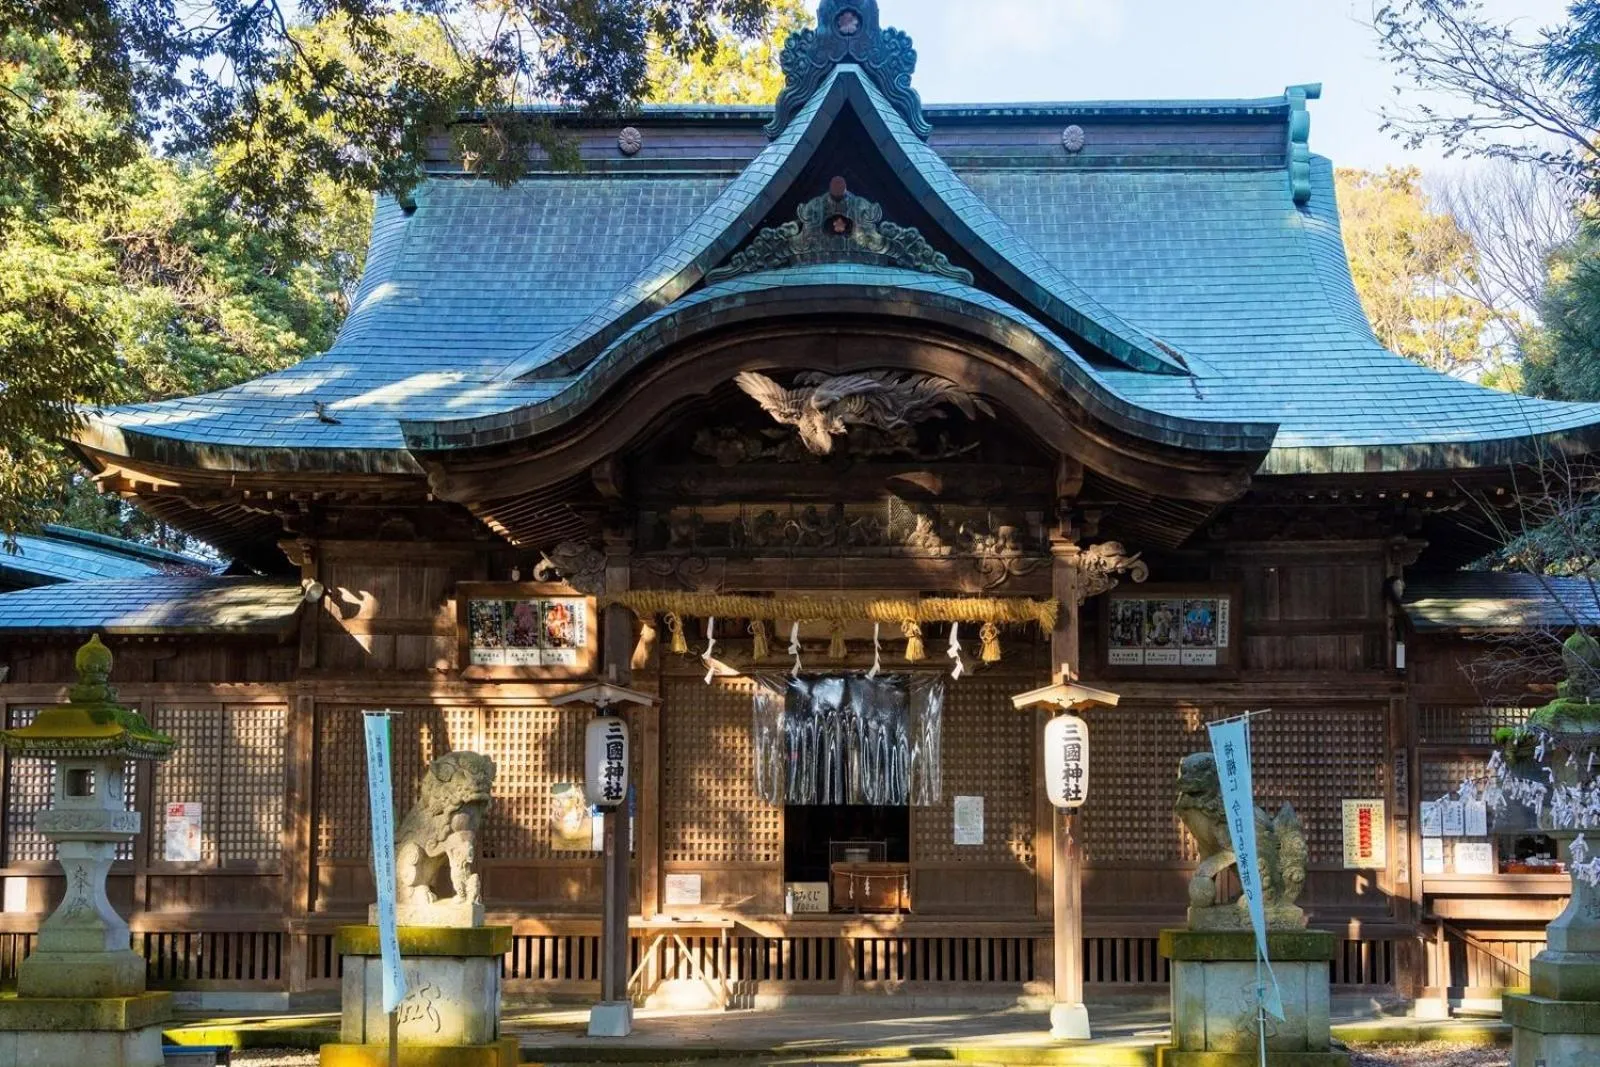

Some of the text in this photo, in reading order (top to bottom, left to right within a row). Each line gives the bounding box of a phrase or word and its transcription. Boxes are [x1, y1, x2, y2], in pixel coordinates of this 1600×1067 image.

[603, 722, 625, 800] 三國神社
[1062, 724, 1083, 801] 三國神社
